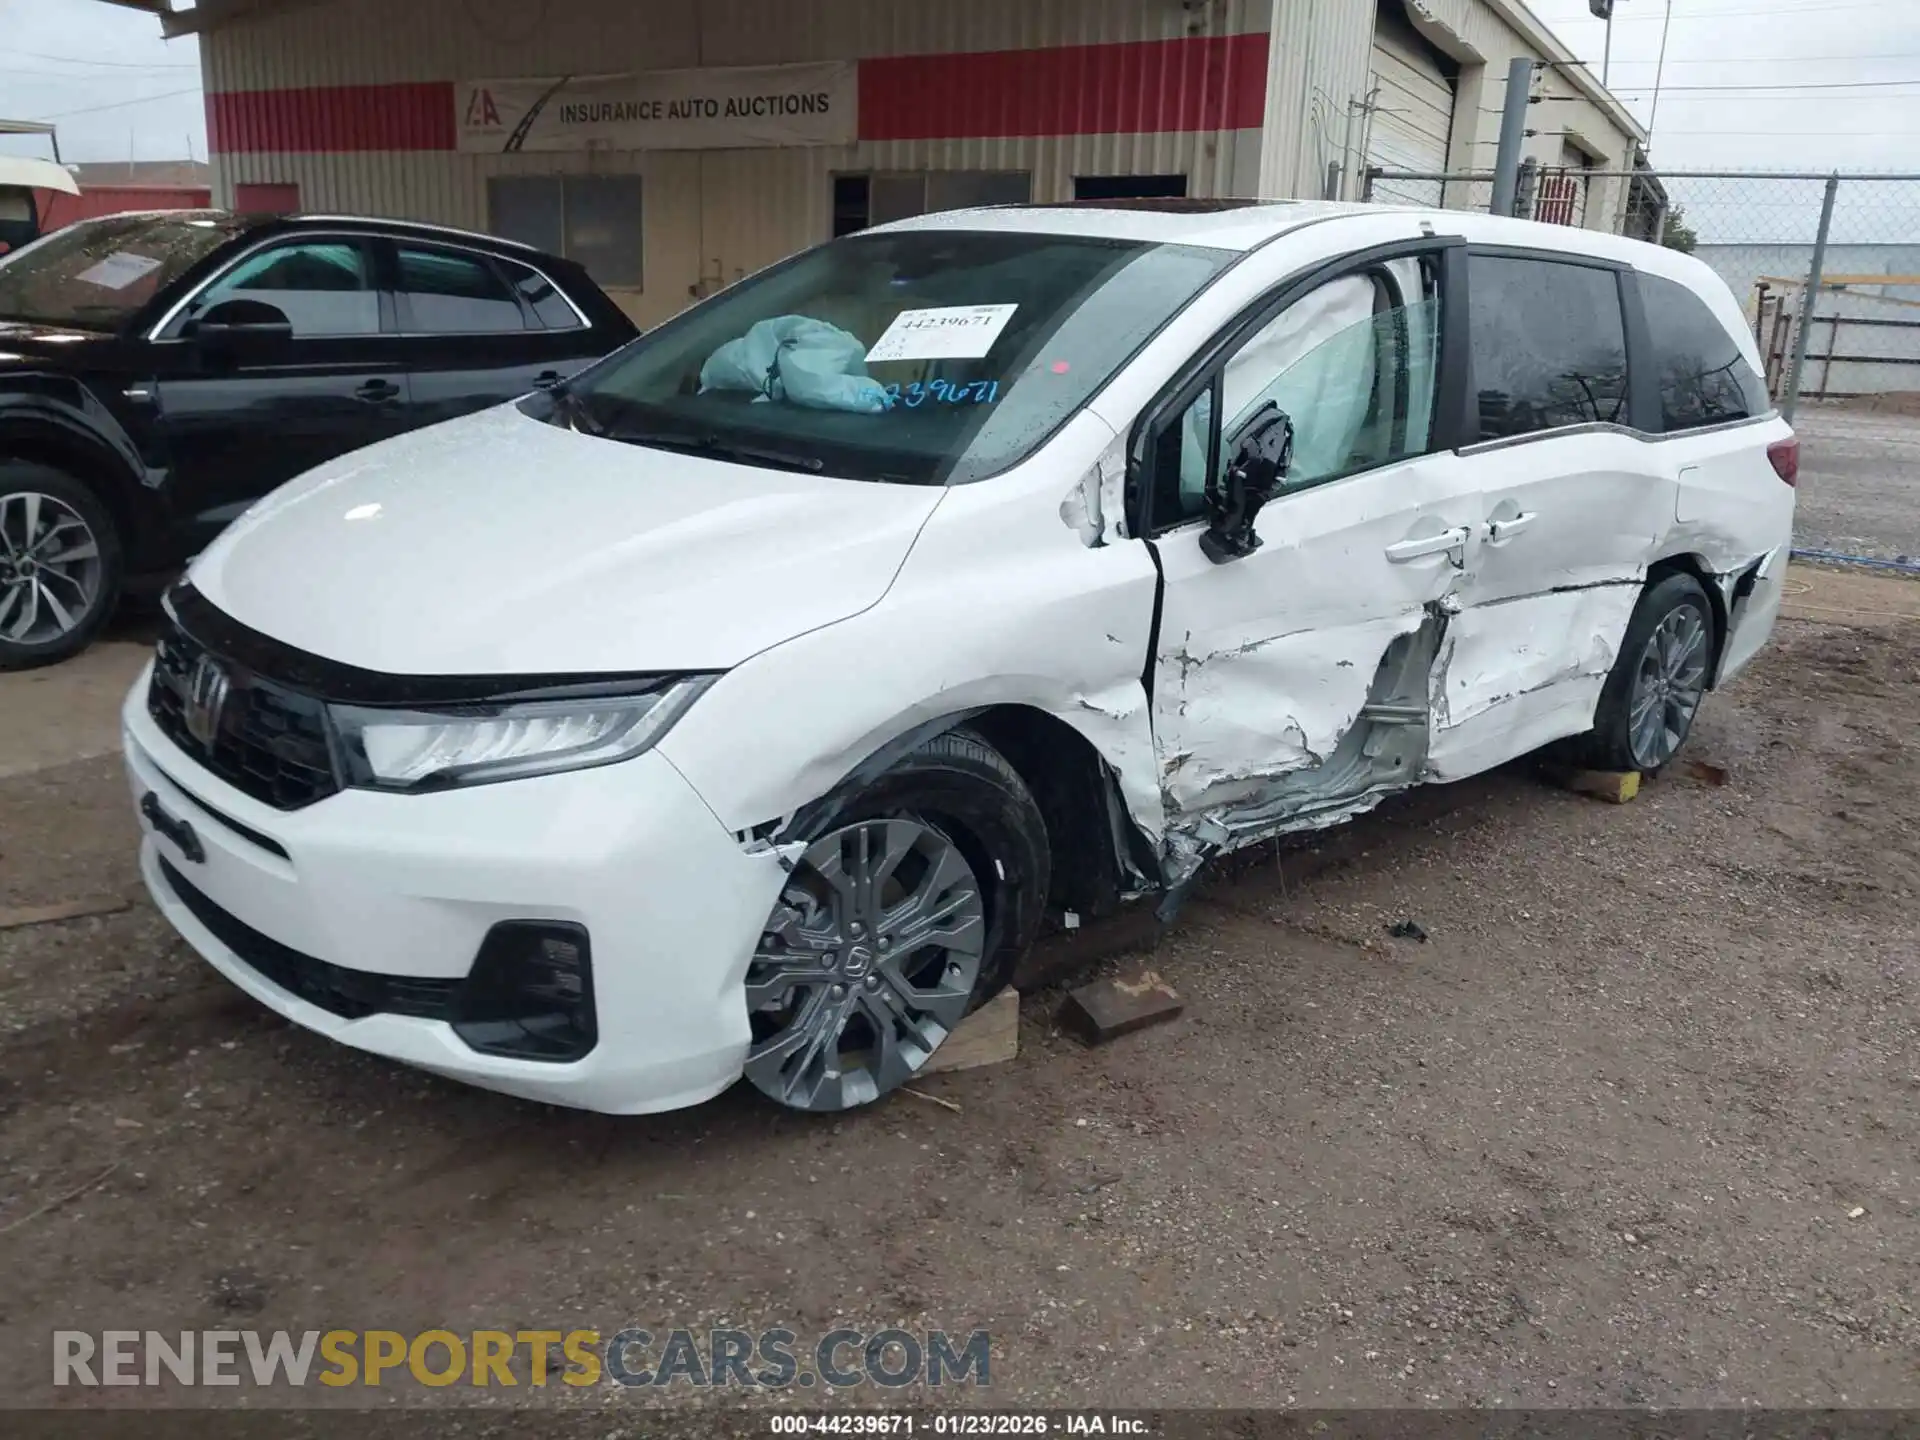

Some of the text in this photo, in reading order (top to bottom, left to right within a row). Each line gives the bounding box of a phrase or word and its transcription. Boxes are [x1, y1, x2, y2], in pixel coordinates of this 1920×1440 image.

[560, 92, 830, 124] INSURANCE AUTO AUCTIONS
